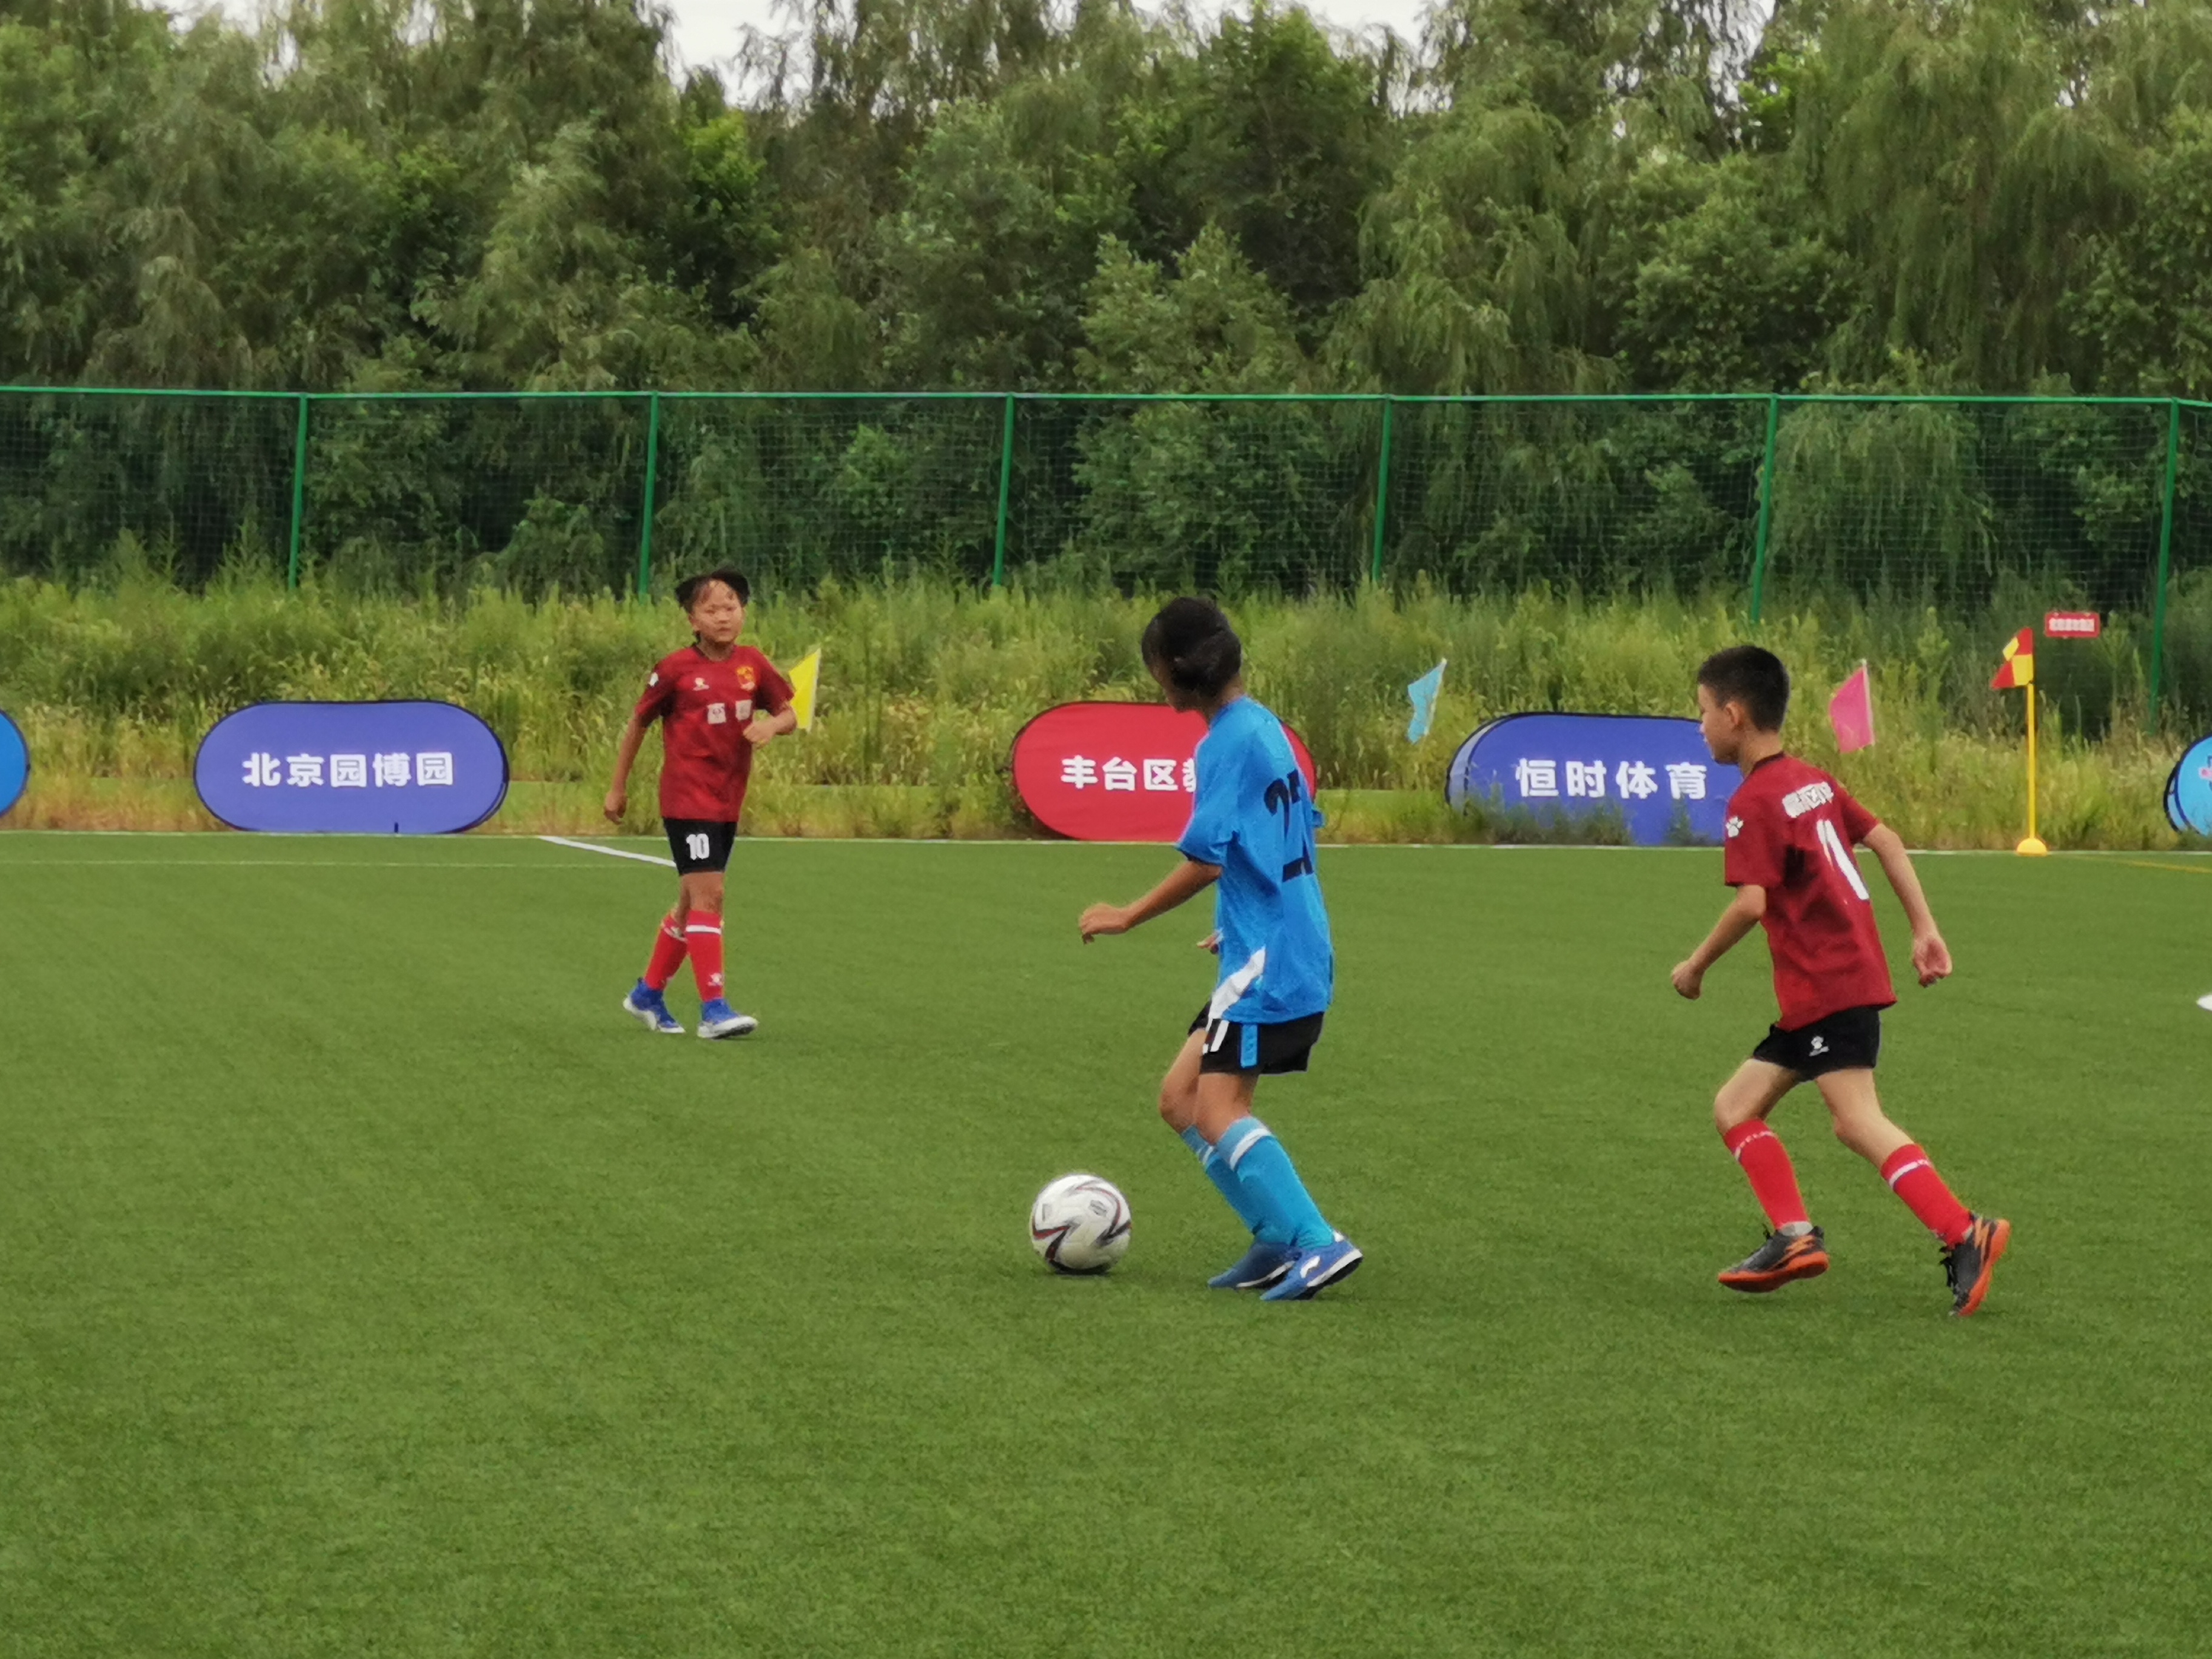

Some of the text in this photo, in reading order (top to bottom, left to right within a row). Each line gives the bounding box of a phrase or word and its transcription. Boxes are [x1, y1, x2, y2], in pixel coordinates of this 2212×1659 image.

[242, 752, 454, 788] 北京园博园
[1515, 758, 1707, 799] 恒时体育
[686, 833, 710, 860] 10
